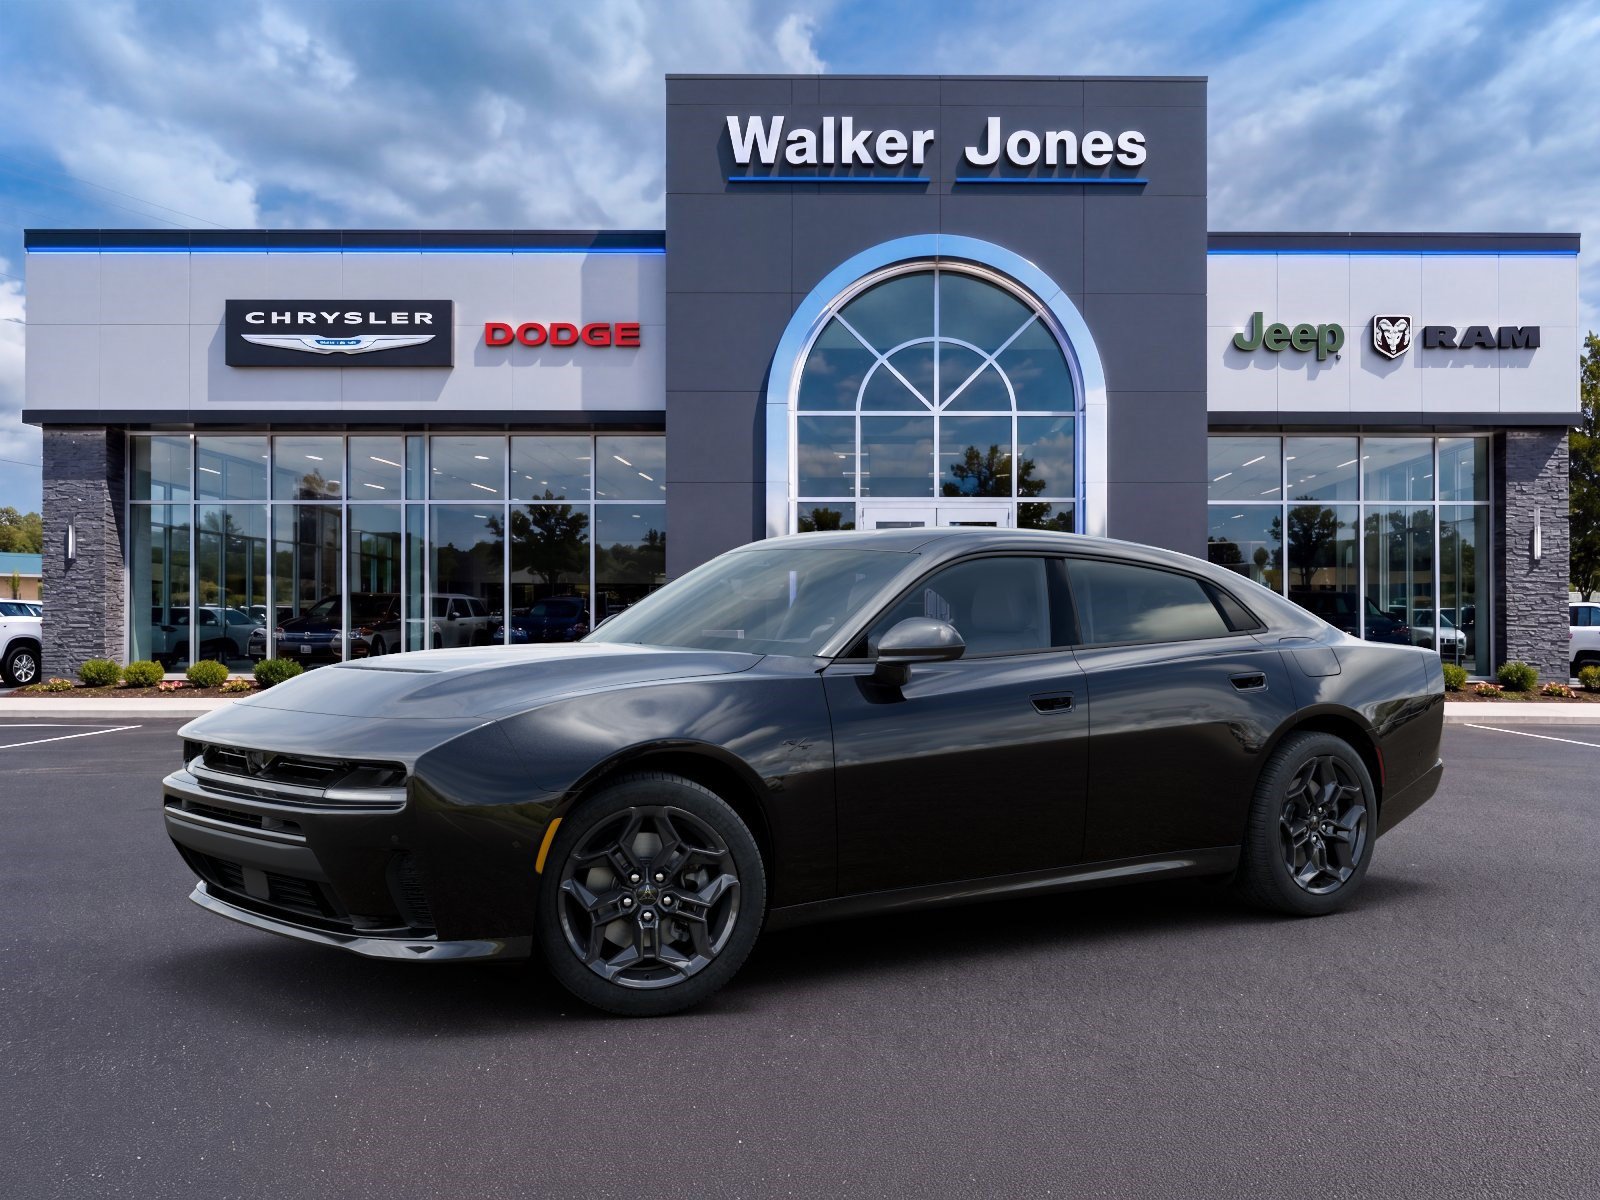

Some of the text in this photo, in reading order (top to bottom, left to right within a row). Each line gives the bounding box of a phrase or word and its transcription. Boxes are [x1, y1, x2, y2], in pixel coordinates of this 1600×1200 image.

[726, 115, 1147, 166] Walker Jones
[245, 311, 434, 325] CHRYSLER
[484, 322, 640, 347] DODGE
[1233, 311, 1345, 361] Jeep
[1424, 325, 1541, 348] RAM
